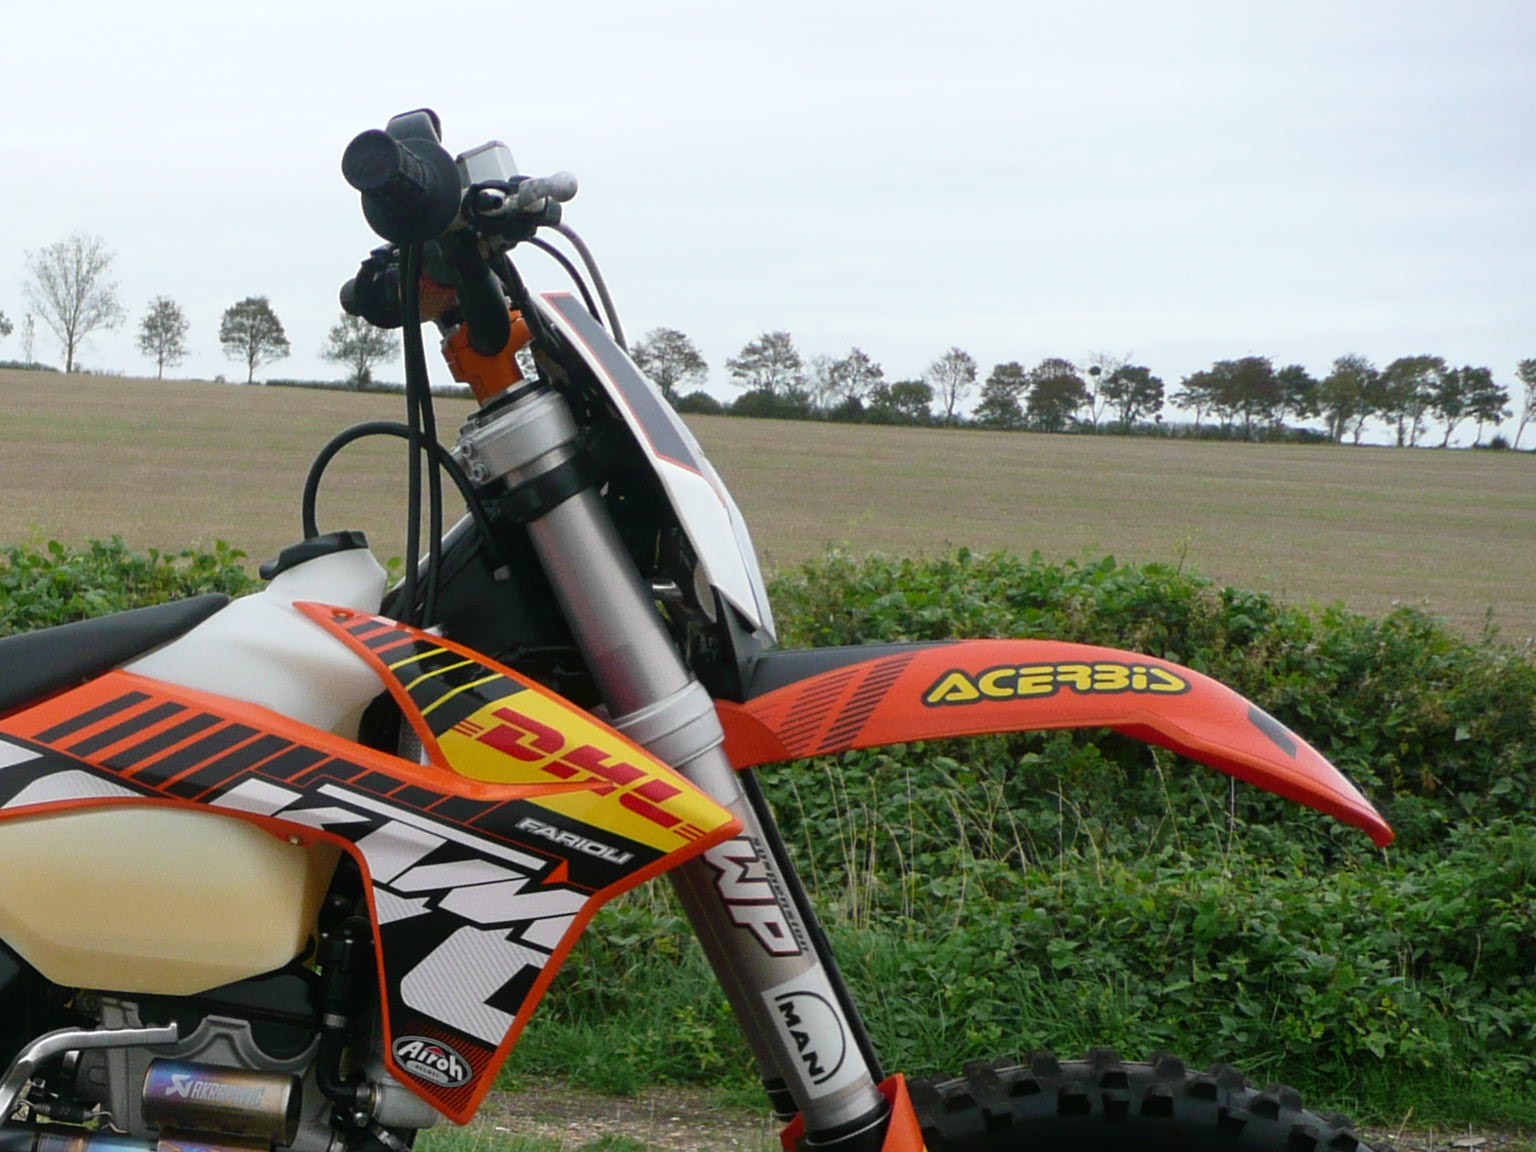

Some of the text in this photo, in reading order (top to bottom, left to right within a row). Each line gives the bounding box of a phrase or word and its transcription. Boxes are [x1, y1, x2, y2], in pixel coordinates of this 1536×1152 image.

[474, 706, 684, 830] DHL
[515, 817, 635, 867] FARIOLI
[704, 836, 804, 957] WP
[396, 1041, 464, 1081] Airoh
[778, 1000, 825, 1083] MAN
